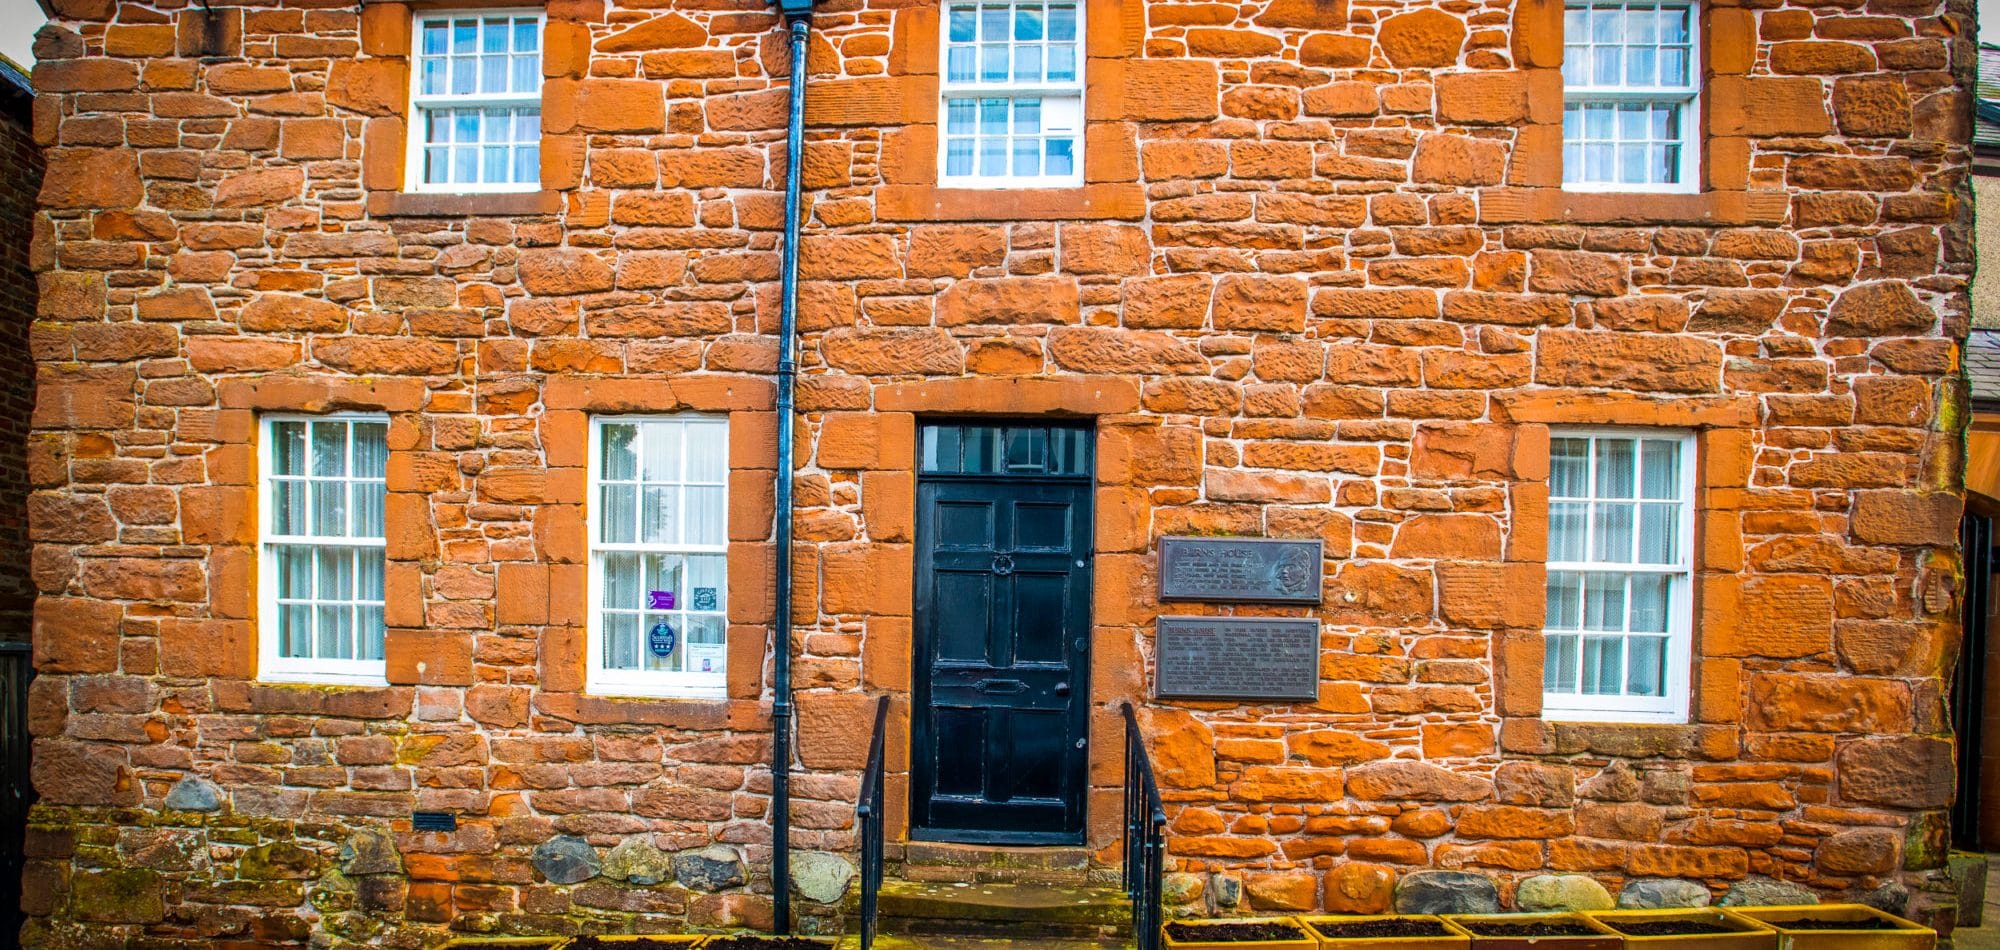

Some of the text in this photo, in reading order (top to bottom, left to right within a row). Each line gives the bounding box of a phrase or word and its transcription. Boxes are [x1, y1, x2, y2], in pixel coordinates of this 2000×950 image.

[1182, 547, 1253, 559] BURNS HOUSE
[1194, 627, 1216, 635] OUSE
